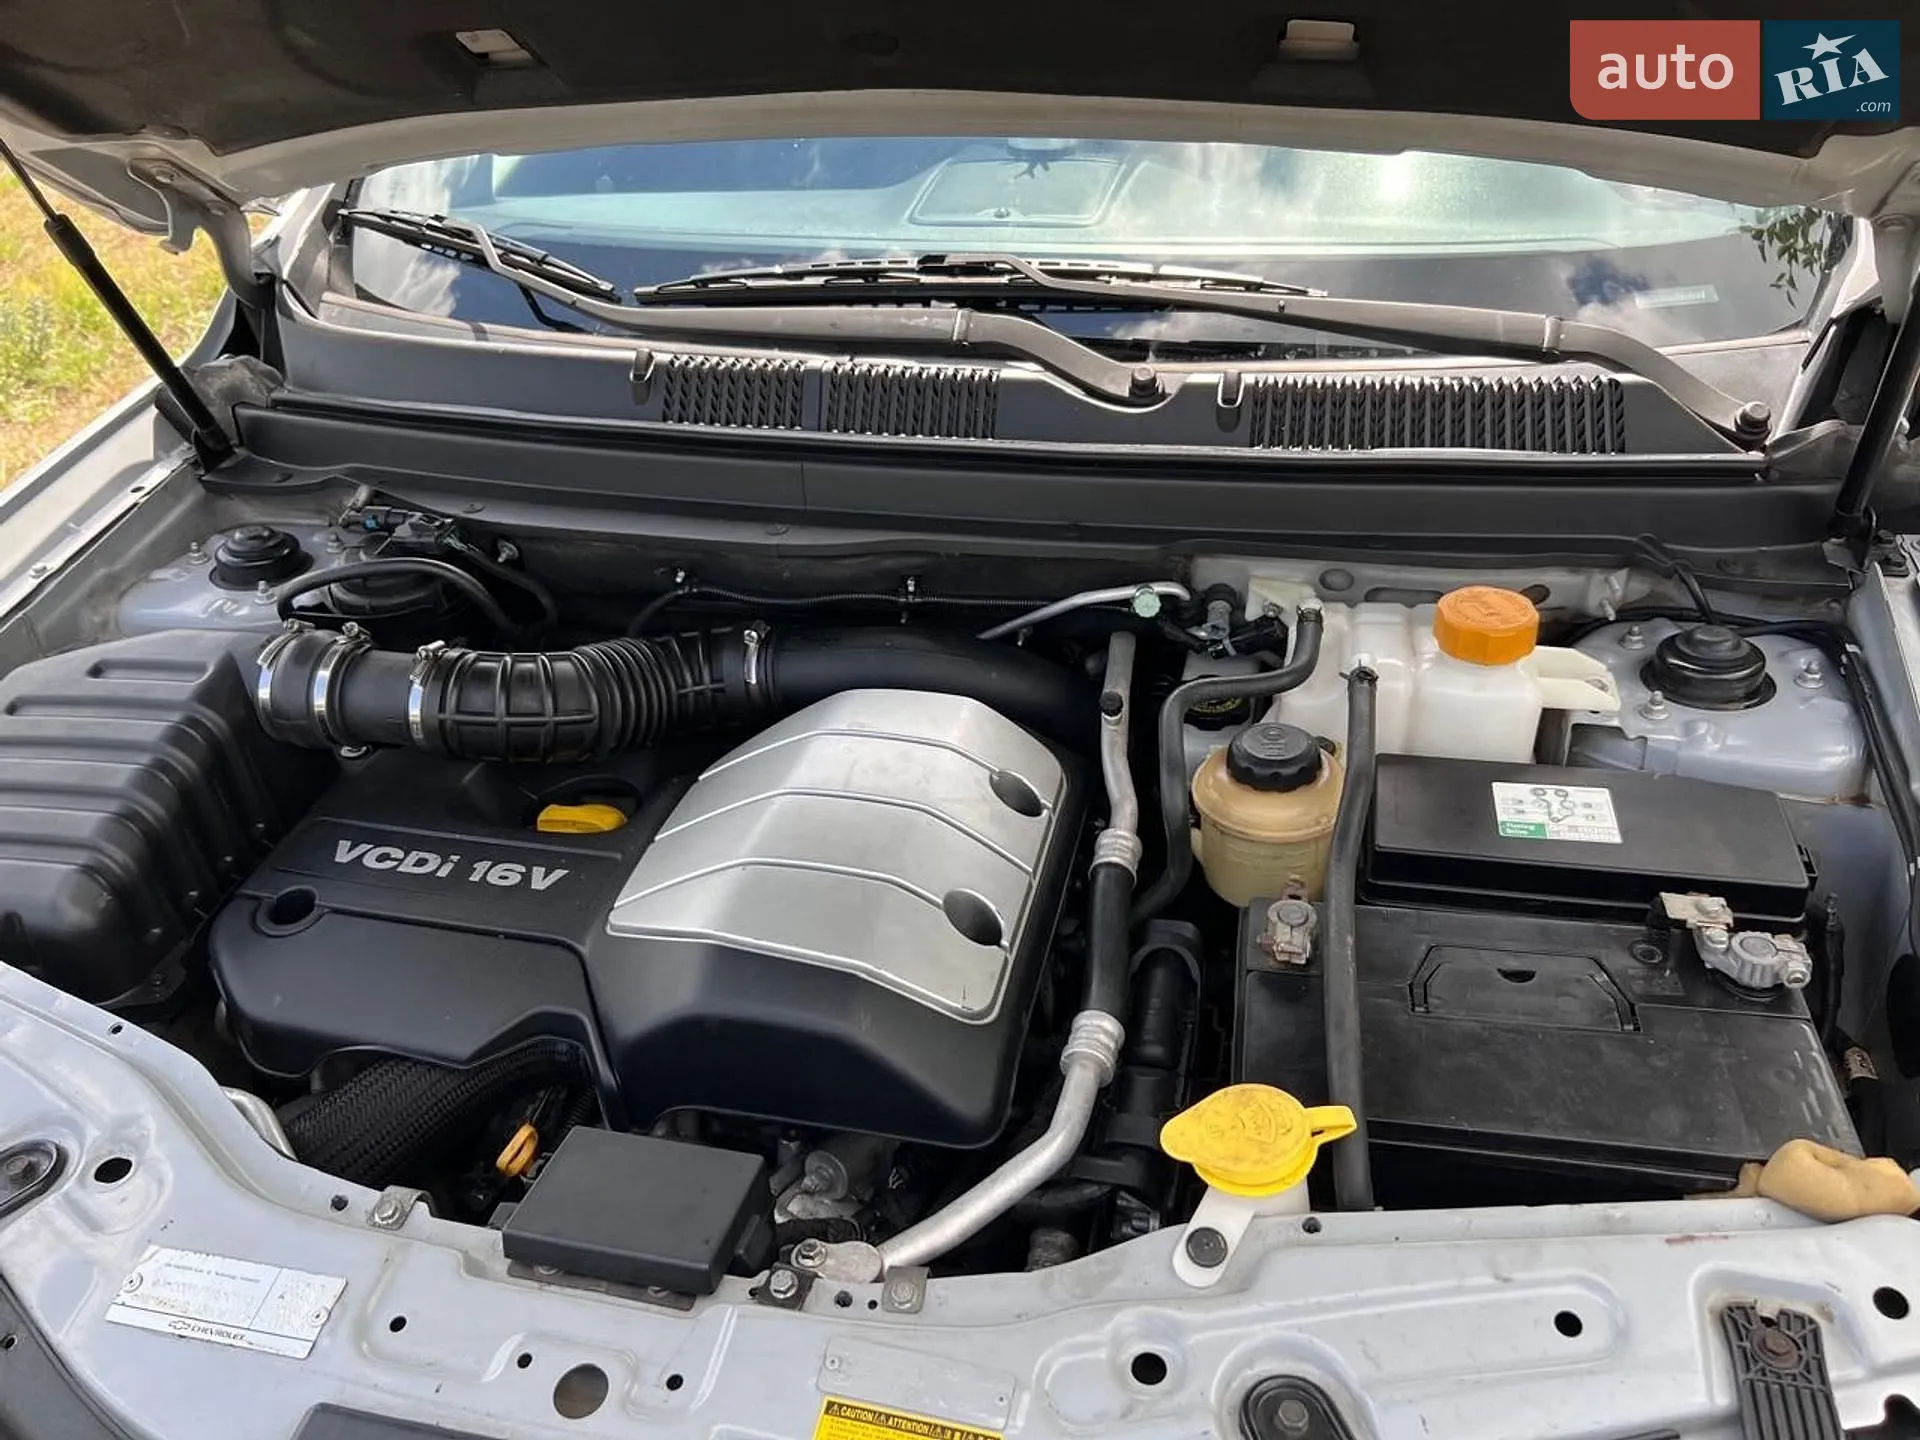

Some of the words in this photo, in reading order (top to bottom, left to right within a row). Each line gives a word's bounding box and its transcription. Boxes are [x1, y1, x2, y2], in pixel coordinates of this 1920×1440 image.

[334, 839, 461, 878] VCDi
[468, 860, 570, 891] 16V
[191, 1325, 246, 1341] CHEVROLET
